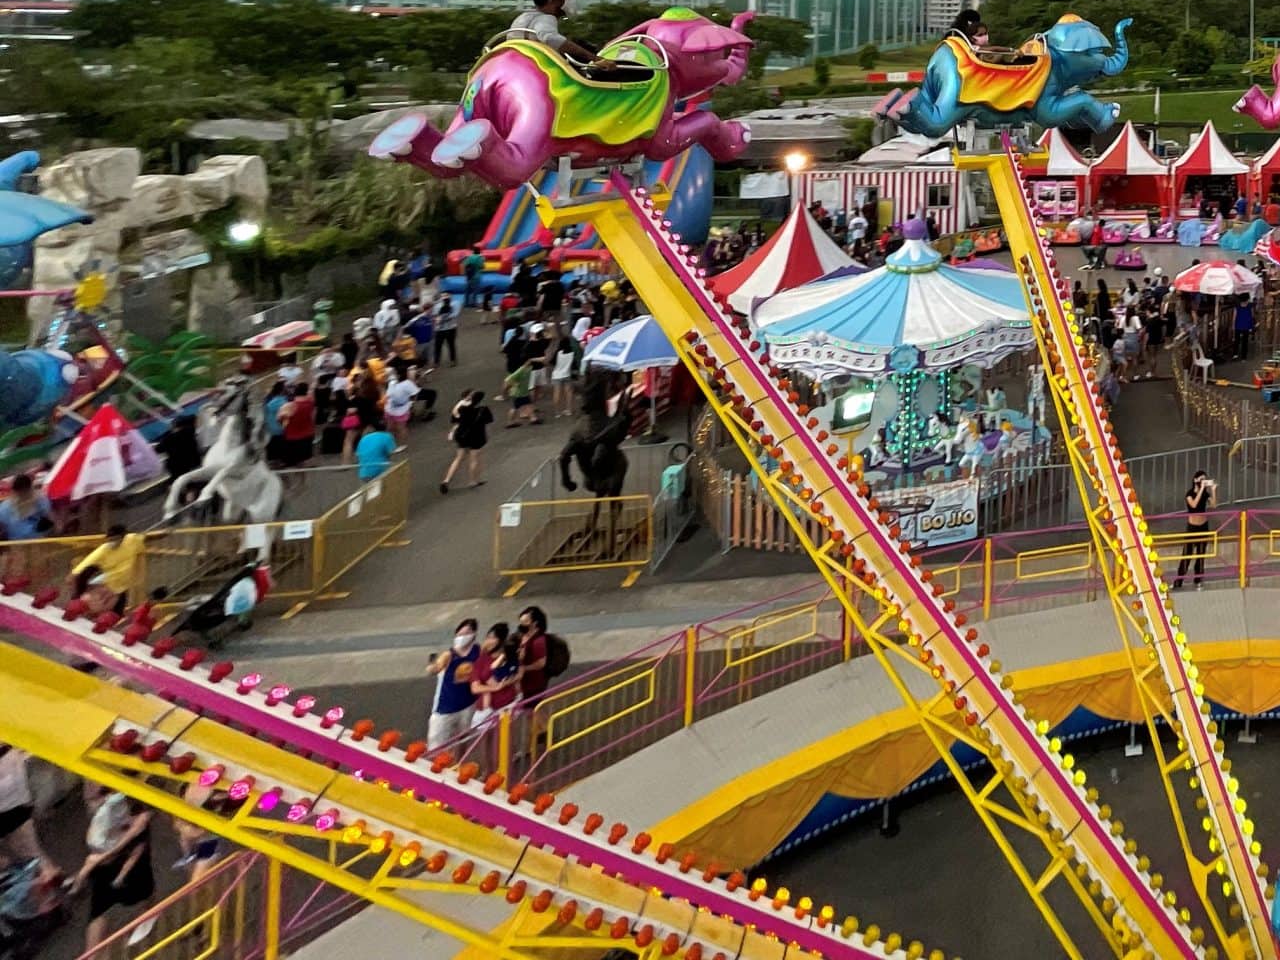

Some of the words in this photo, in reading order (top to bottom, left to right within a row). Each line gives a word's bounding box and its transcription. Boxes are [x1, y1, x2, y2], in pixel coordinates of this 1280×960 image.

[931, 332, 1030, 363] CARROUSE
[920, 514, 945, 532] BO
[946, 509, 976, 528] JIO
